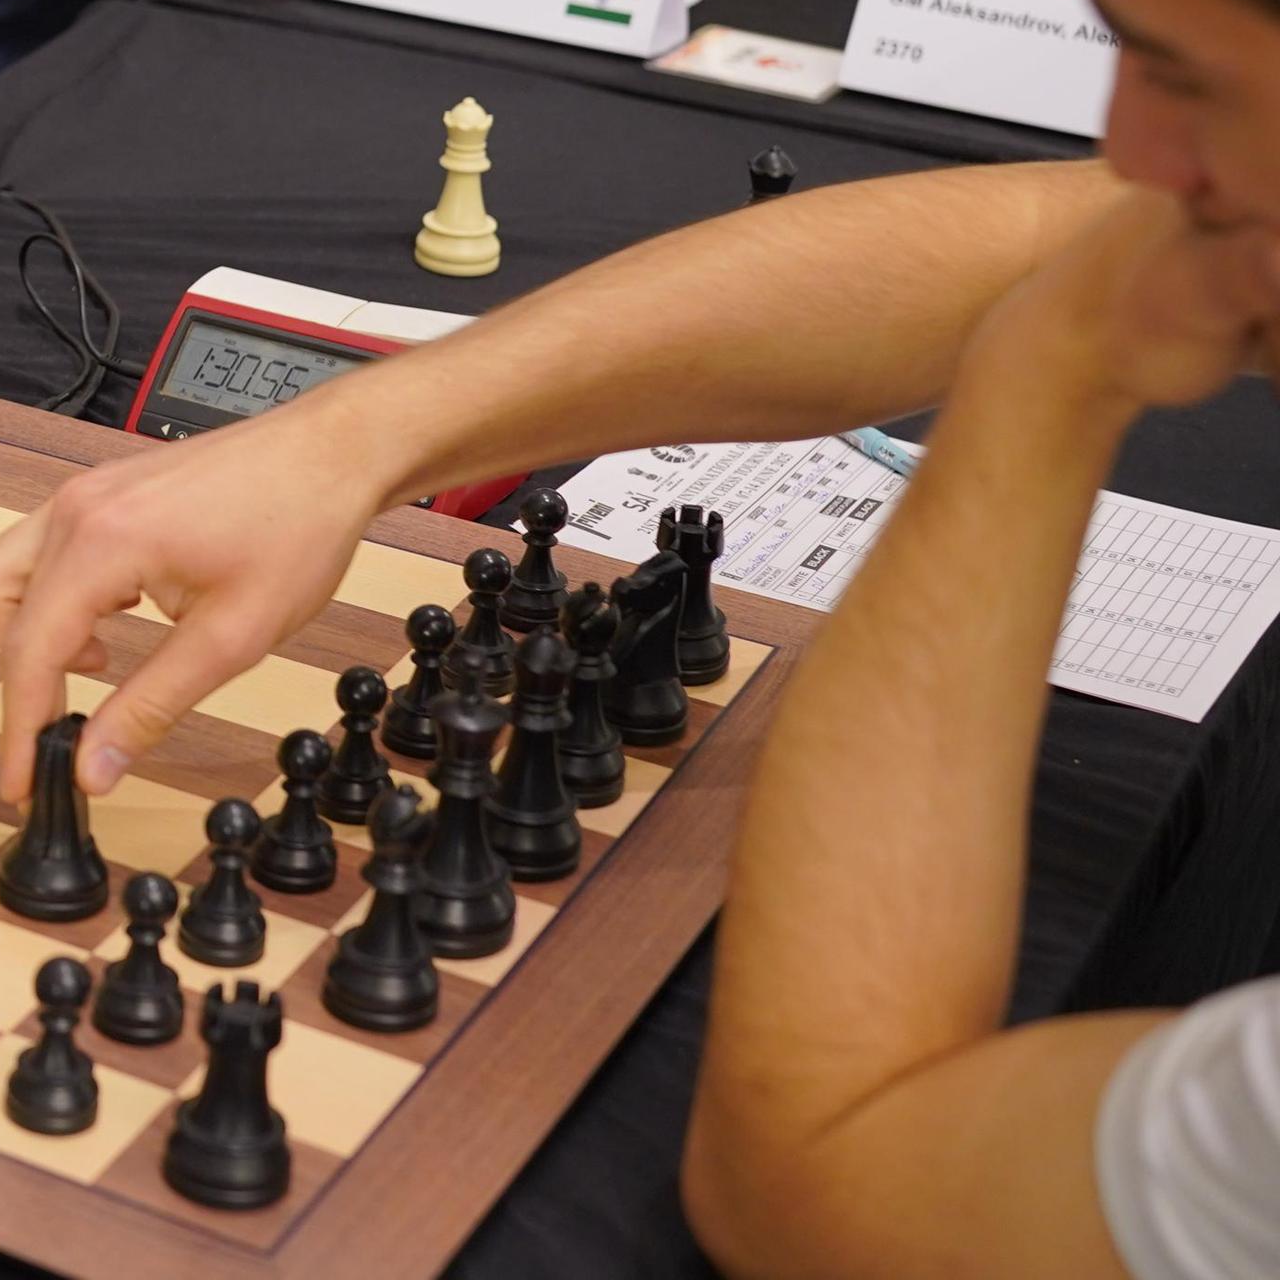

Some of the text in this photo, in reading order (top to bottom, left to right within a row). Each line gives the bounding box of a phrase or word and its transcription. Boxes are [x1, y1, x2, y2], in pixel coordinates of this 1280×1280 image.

[874, 36, 925, 63] 2370
[678, 448, 745, 500] INTERNATIONAL
[712, 473, 741, 497] CHESS
[836, 522, 857, 538] WHITE
[854, 501, 879, 519] BLACK
[789, 547, 832, 588] WHITE BLACK
